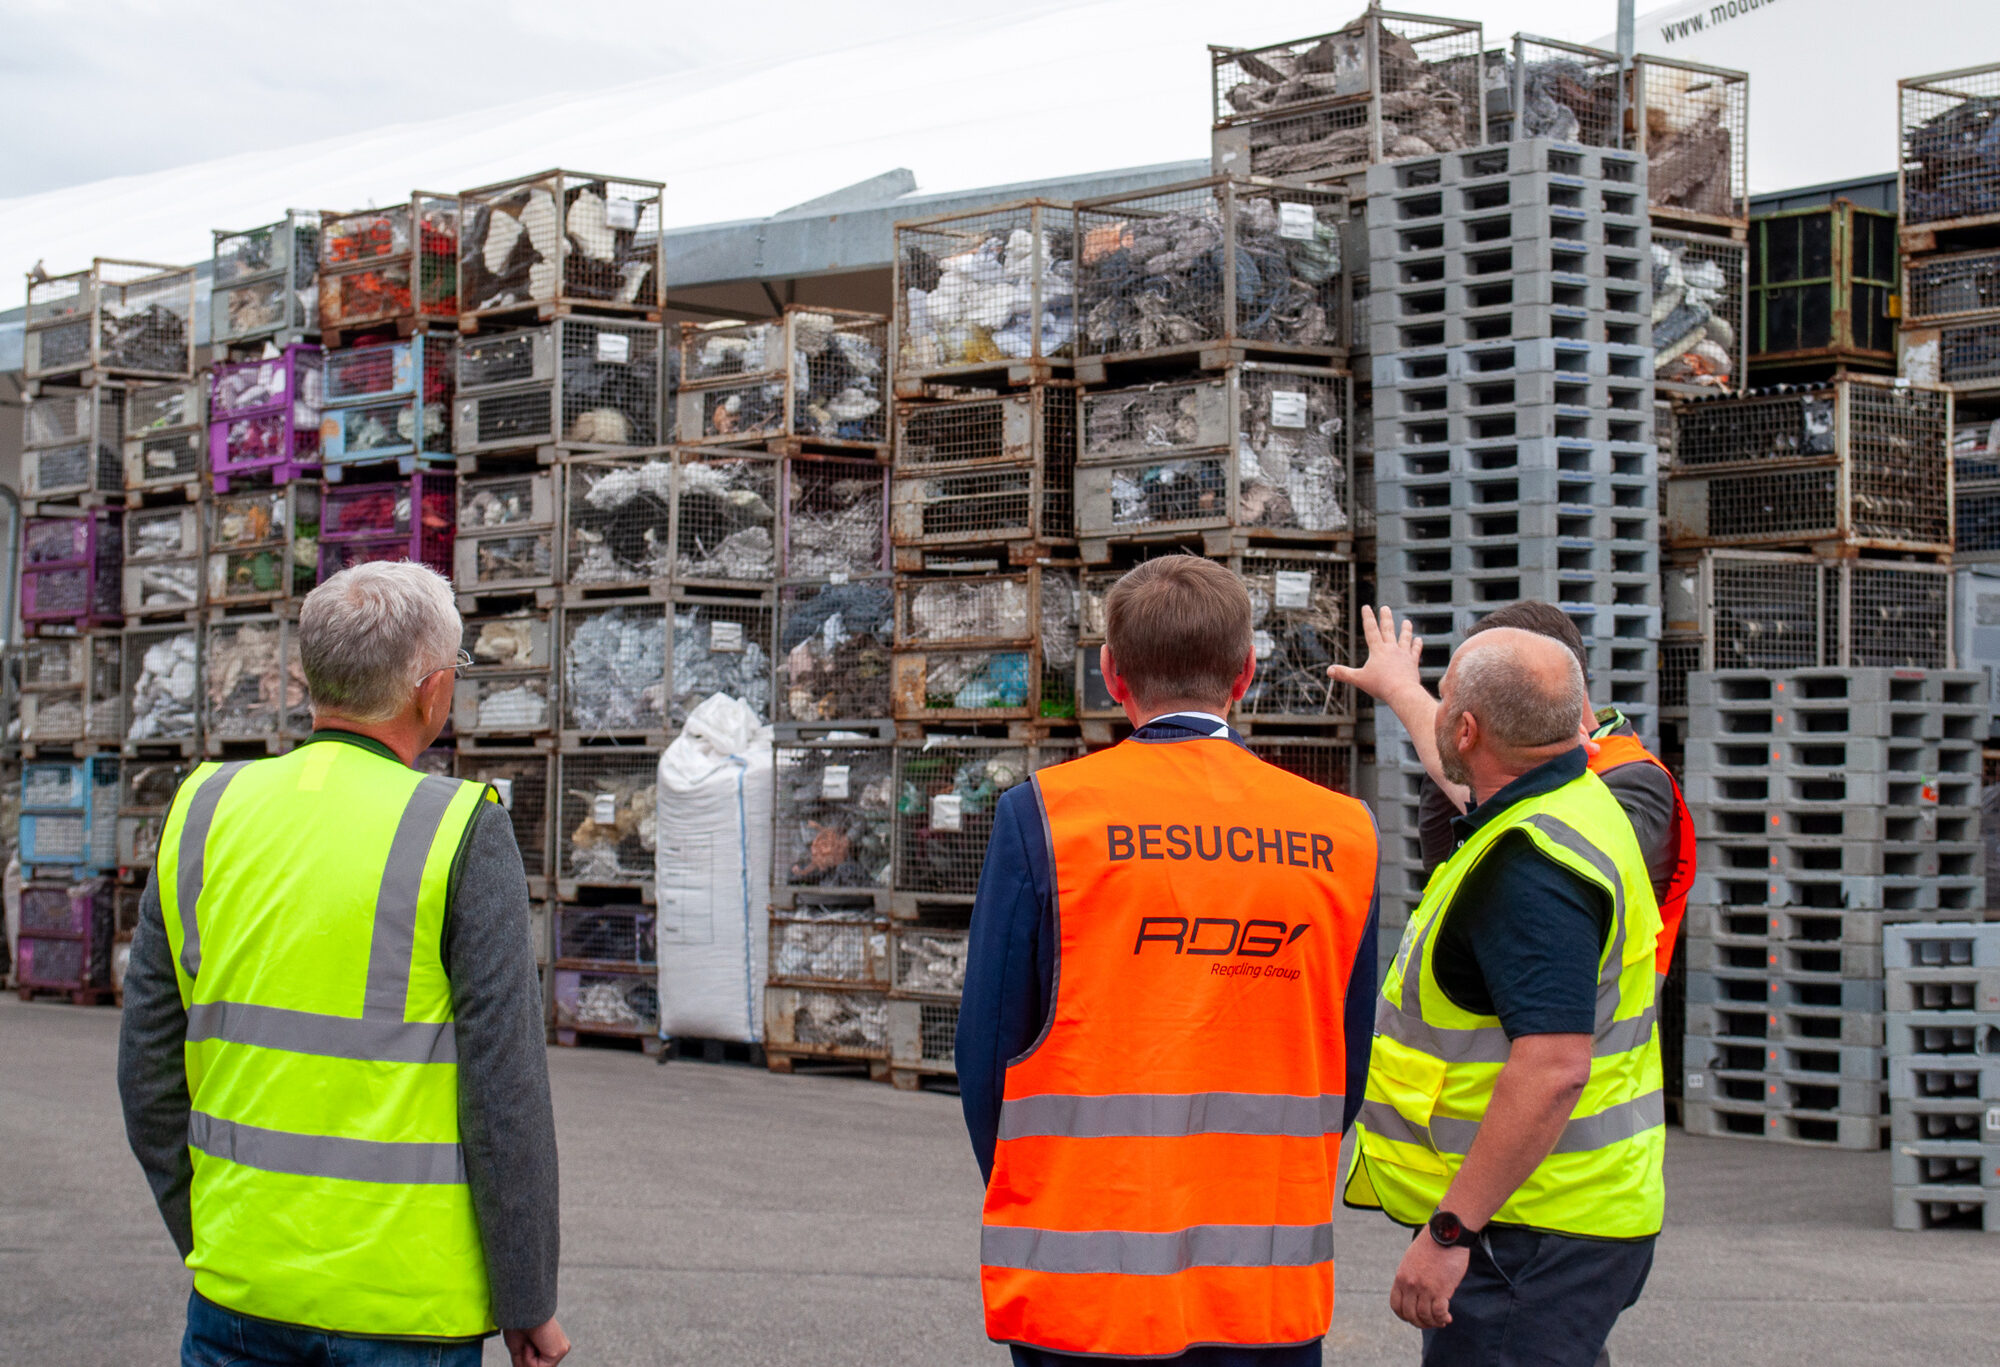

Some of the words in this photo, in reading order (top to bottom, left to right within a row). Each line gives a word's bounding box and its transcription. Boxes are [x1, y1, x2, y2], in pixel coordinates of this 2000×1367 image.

[1107, 824, 1334, 872] BESUCHER
[1133, 917, 1288, 957] RDG
[1264, 964, 1301, 981] Group
